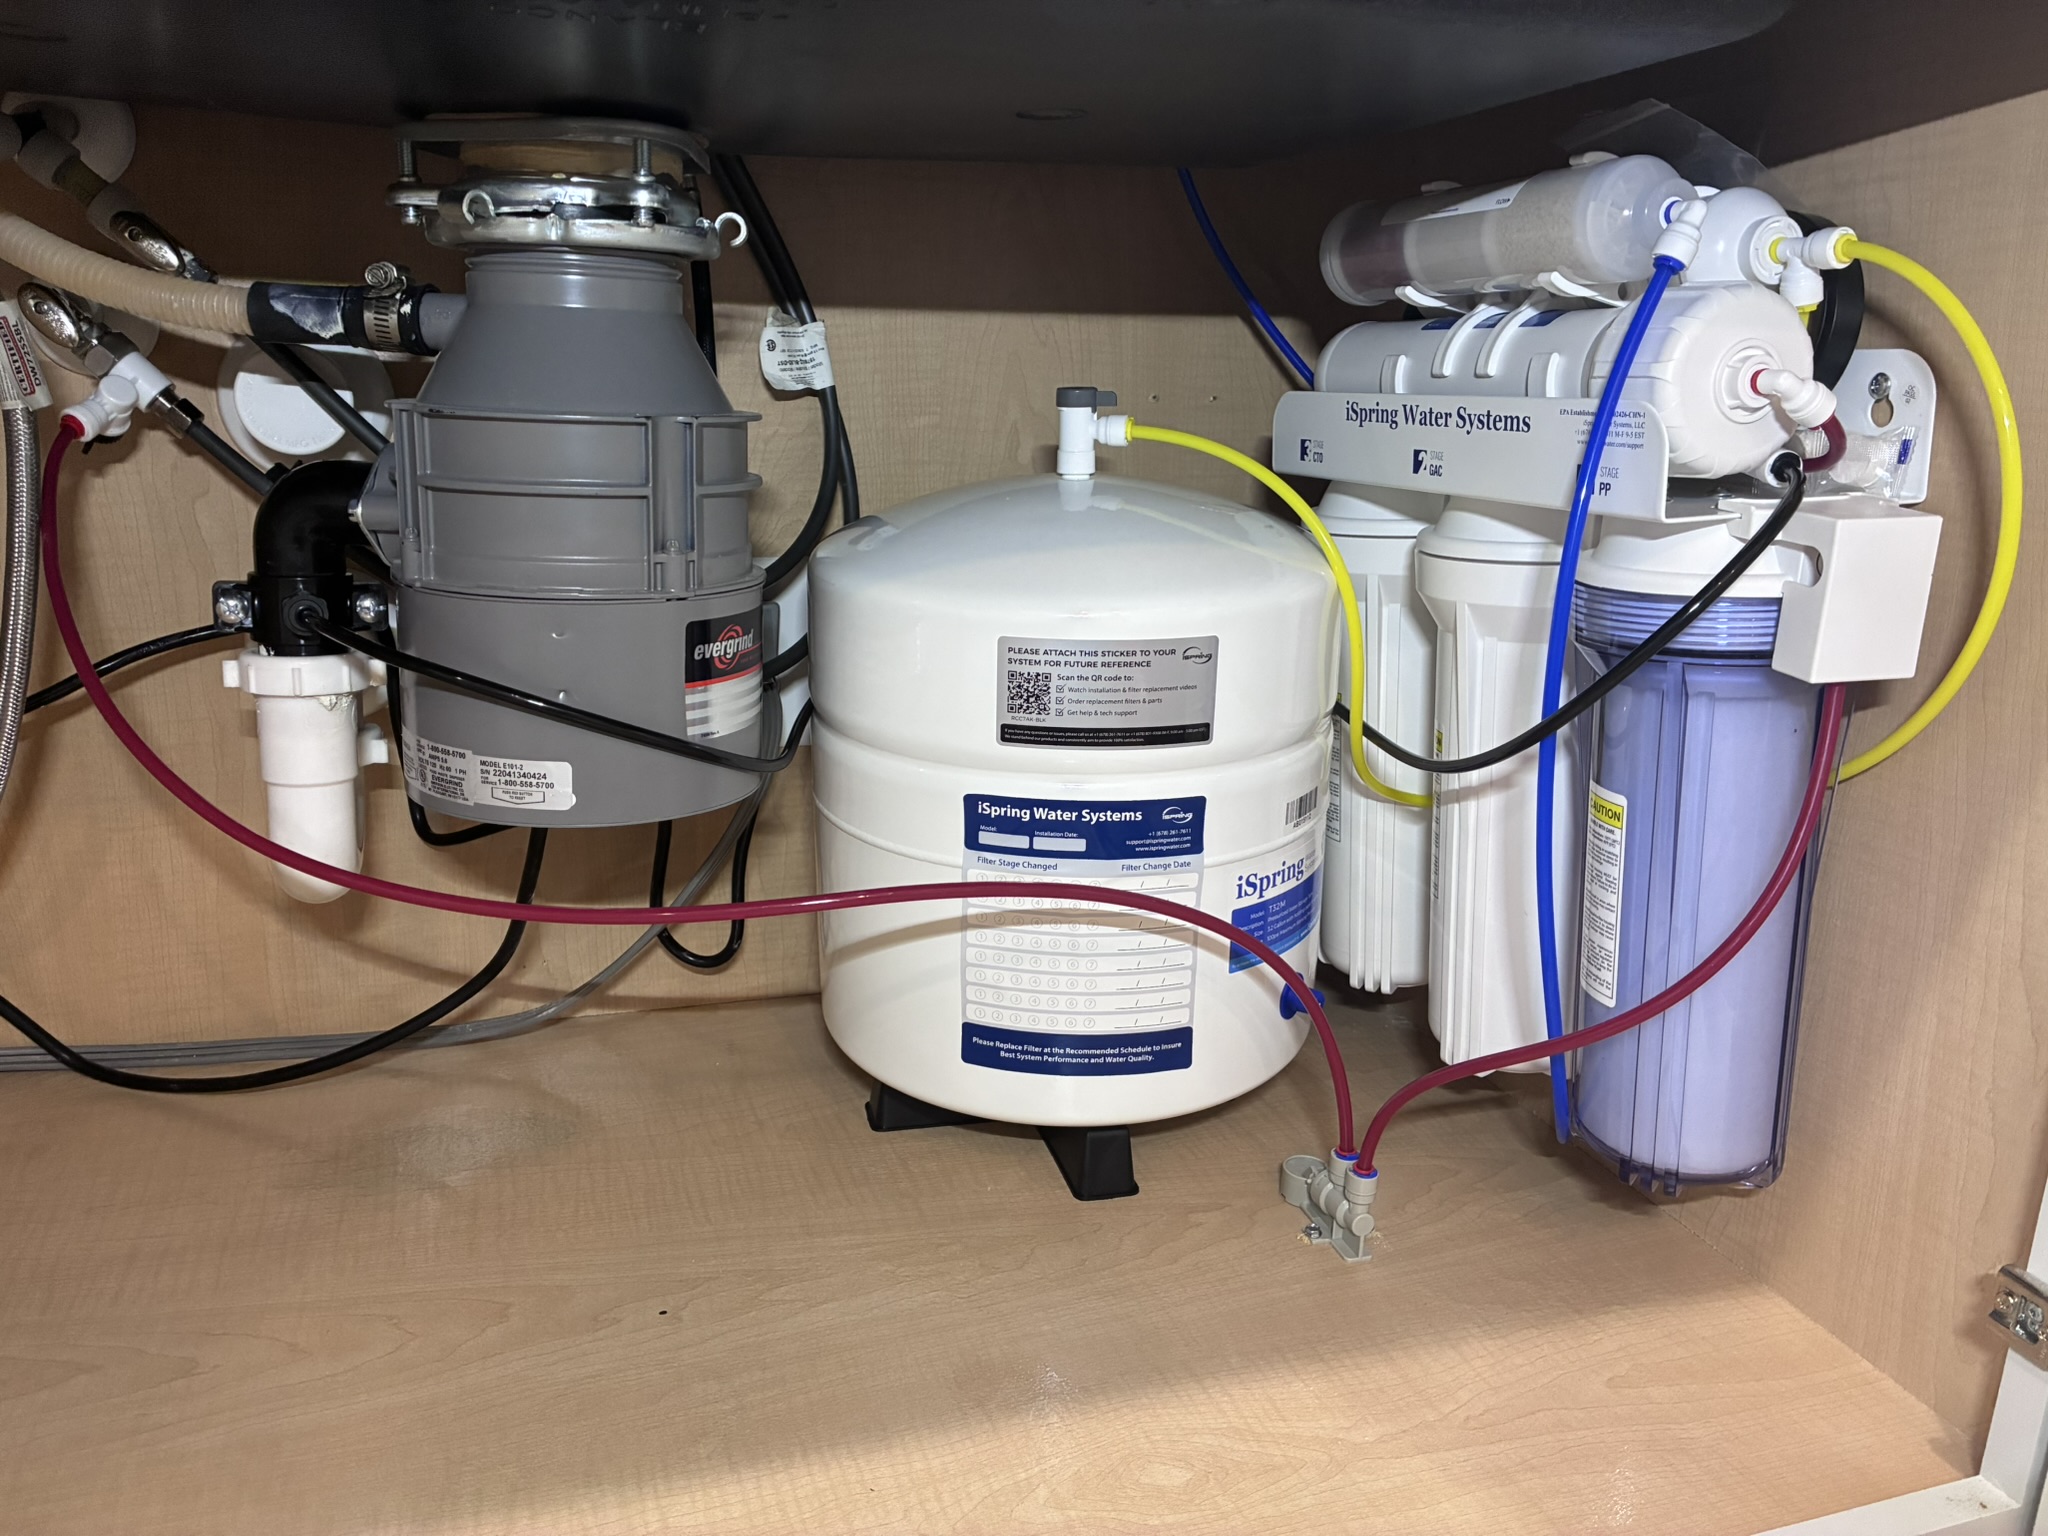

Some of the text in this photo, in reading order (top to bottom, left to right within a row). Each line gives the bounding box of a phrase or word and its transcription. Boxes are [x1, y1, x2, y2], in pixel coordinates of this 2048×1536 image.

[1345, 400, 1531, 435] iSpring Water Systems
[1560, 408, 1570, 416] EPA
[1570, 409, 1596, 417] Establishm
[1634, 421, 1646, 429] LLC
[1312, 440, 1324, 449] STAGE
[1313, 452, 1324, 463] CTO
[1430, 450, 1444, 461] STAGE
[1429, 463, 1443, 477] GAC
[1601, 466, 1619, 479] STAGE
[1599, 482, 1611, 496] PP
[694, 628, 754, 660] evergrind
[1007, 647, 1040, 655] PLEASE
[1042, 649, 1076, 657] ATTACH
[1007, 658, 1041, 666] SYSTEM
[1143, 685, 1178, 693] replacement
[480, 760, 523, 771] MODEL E101-2
[492, 769, 547, 780] 22041340424
[431, 774, 463, 788] EVERGRIND
[498, 779, 554, 789] 1-800-558-5700
[978, 801, 1142, 825] iSpring Water Systems
[1126, 836, 1191, 845] support@ispringwater.com
[1135, 843, 1190, 851] www.ispringwater.com
[977, 856, 1058, 871] Filter Stage Changed
[1121, 864, 1141, 872] Filter
[1143, 862, 1172, 871] Change
[1235, 857, 1304, 899] iSpring
[972, 1037, 994, 1046] Please
[995, 1041, 1022, 1050] Replace
[1161, 1042, 1182, 1050] Insure
[1000, 1050, 1015, 1058] Best
[1016, 1053, 1042, 1061] System
[1043, 1055, 1089, 1063] Performance
[1127, 1054, 1154, 1062] Quality.
